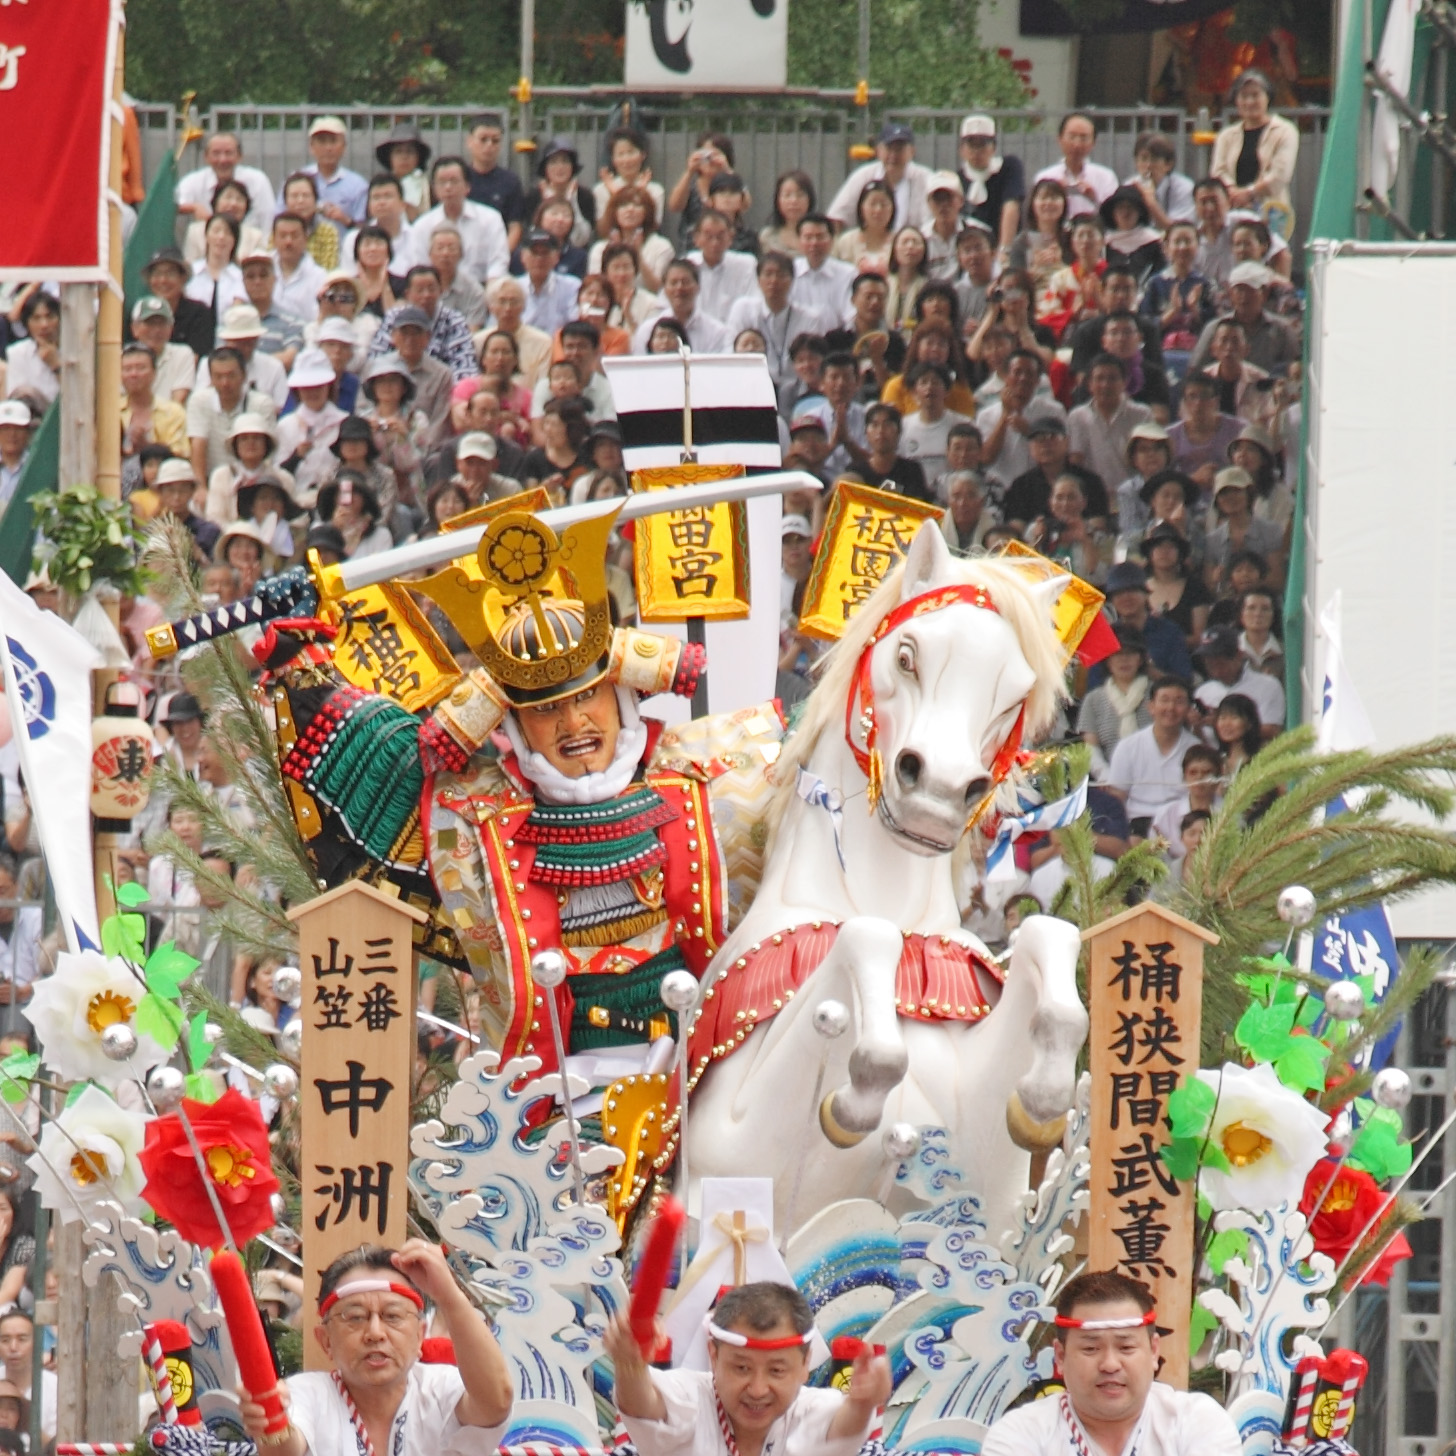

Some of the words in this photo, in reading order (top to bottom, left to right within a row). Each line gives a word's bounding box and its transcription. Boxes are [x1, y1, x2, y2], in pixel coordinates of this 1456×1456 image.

[110, 738, 146, 783] 東
[311, 936, 355, 1031] 山笠
[355, 937, 403, 1033] 三番
[313, 1059, 395, 1275] 中洲
[1107, 940, 1186, 1335] 桶狭間武薫
